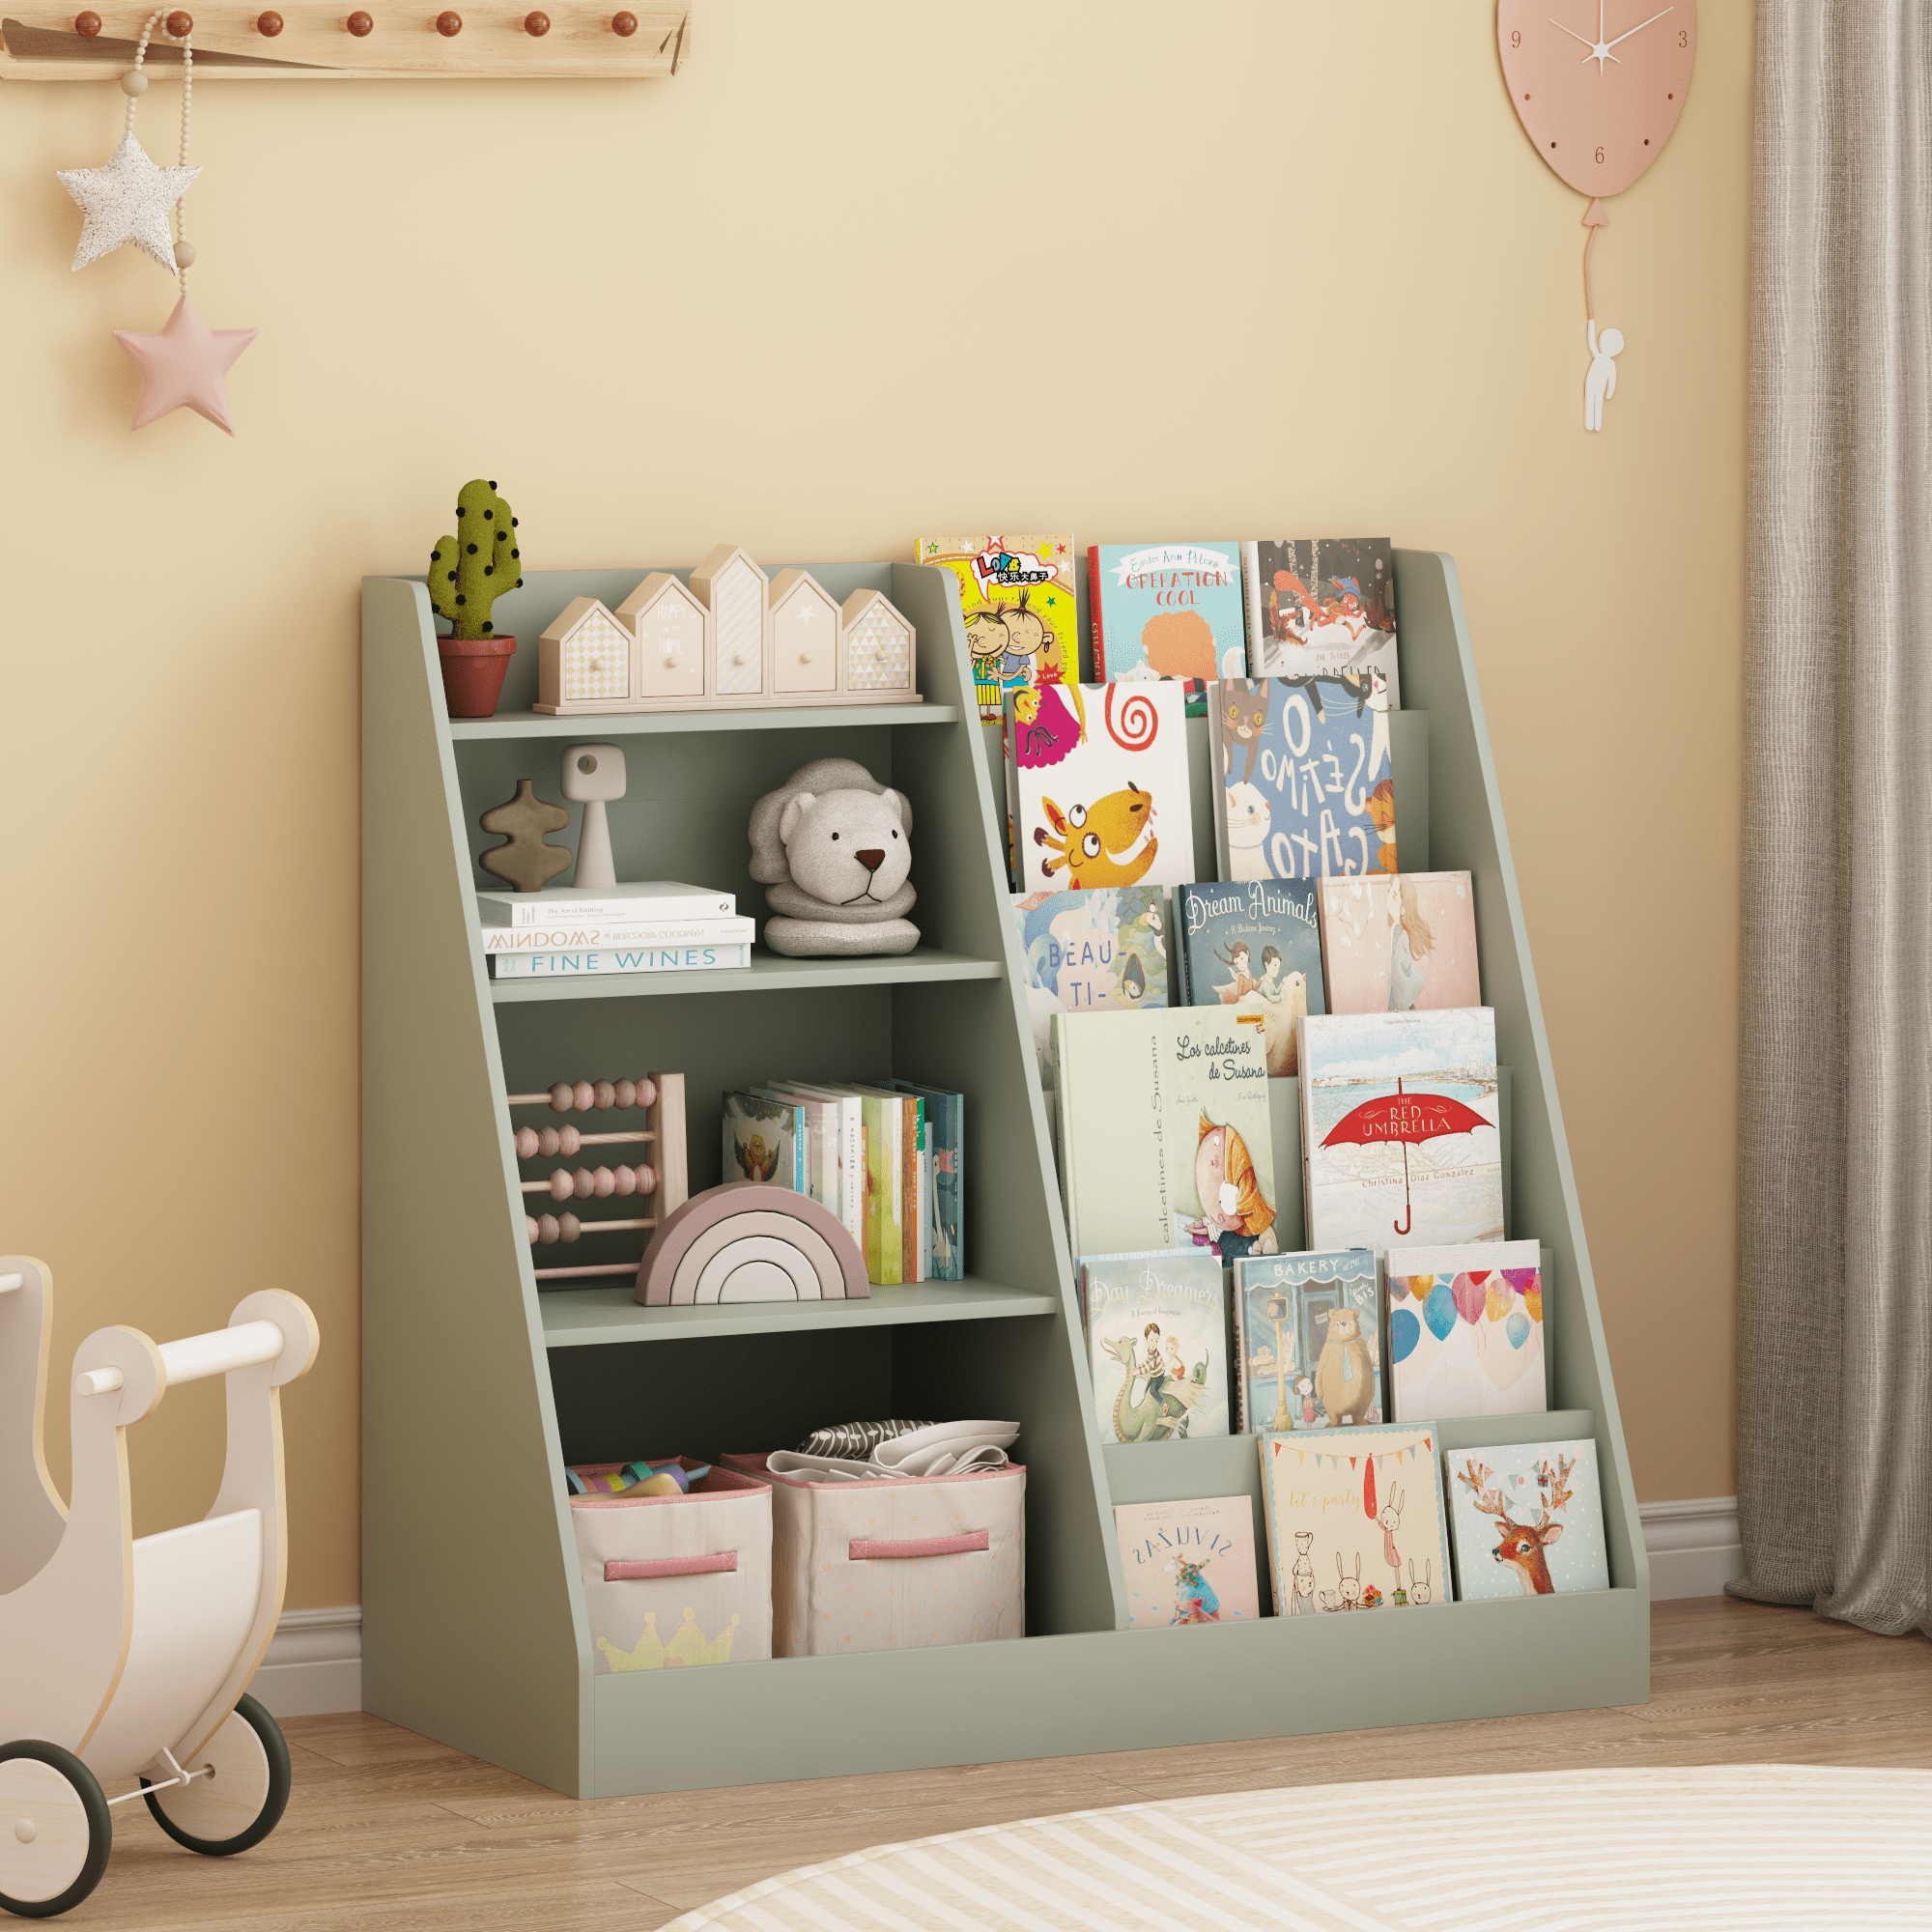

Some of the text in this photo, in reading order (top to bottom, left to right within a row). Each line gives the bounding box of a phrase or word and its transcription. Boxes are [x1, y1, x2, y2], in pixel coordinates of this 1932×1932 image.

[1511, 30, 1521, 48] 9
[1678, 30, 1688, 48] 3
[1595, 146, 1605, 164] 6
[1125, 571, 1228, 589] OPERATION
[1155, 589, 1200, 607] COOL
[657, 604, 688, 620] HAPPY
[659, 638, 684, 654] HOME
[1185, 880, 1318, 936] Dream Animals
[532, 953, 599, 972] FINE
[614, 949, 716, 968] WINES
[1049, 940, 1126, 967] BEAU-
[1069, 981, 1106, 1006] TI-
[1177, 1035, 1251, 1061] Los calcetines
[1208, 1059, 1265, 1080] de Susana
[1390, 1105, 1422, 1121] RED
[1362, 1118, 1451, 1137] UMBRELLA
[1151, 1035, 1170, 1243] calcetines de Susana
[1362, 1178, 1403, 1188] Christina
[1434, 1168, 1474, 1179] Gonzalez
[1274, 1259, 1339, 1277] BAKERY
[1089, 1266, 1218, 1318] Day Dreamers
[1290, 1488, 1361, 1515] let's party
